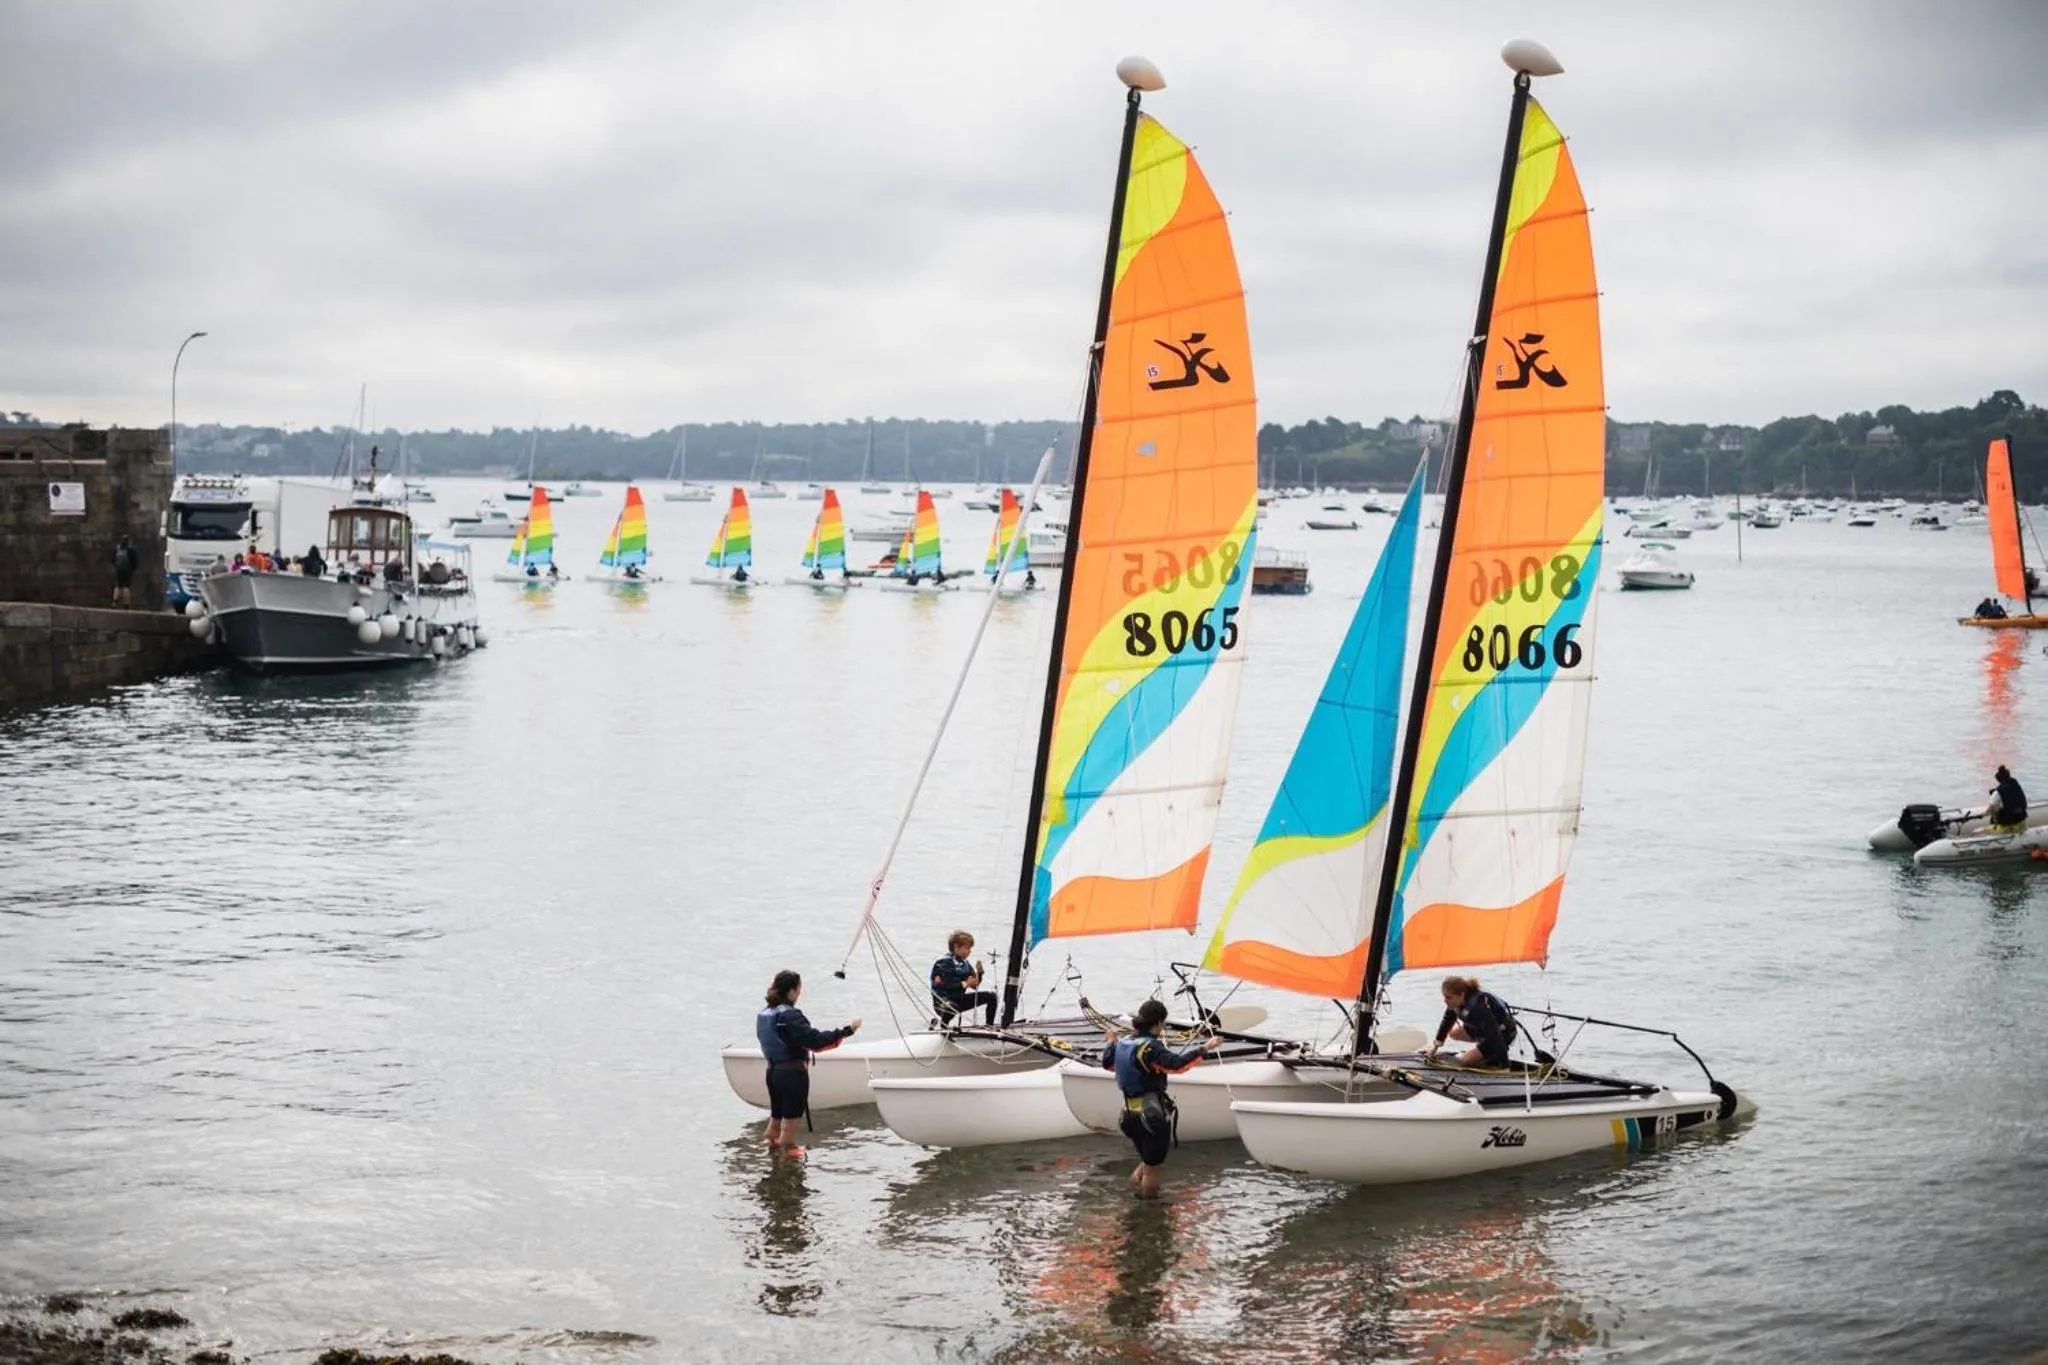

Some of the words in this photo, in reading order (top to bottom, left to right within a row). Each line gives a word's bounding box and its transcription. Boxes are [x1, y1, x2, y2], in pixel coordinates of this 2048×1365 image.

[1123, 606, 1239, 657] 8065
[1463, 623, 1582, 672] 8066
[1480, 1126, 1528, 1148] Hobie
[1659, 1115, 1675, 1132] 15
